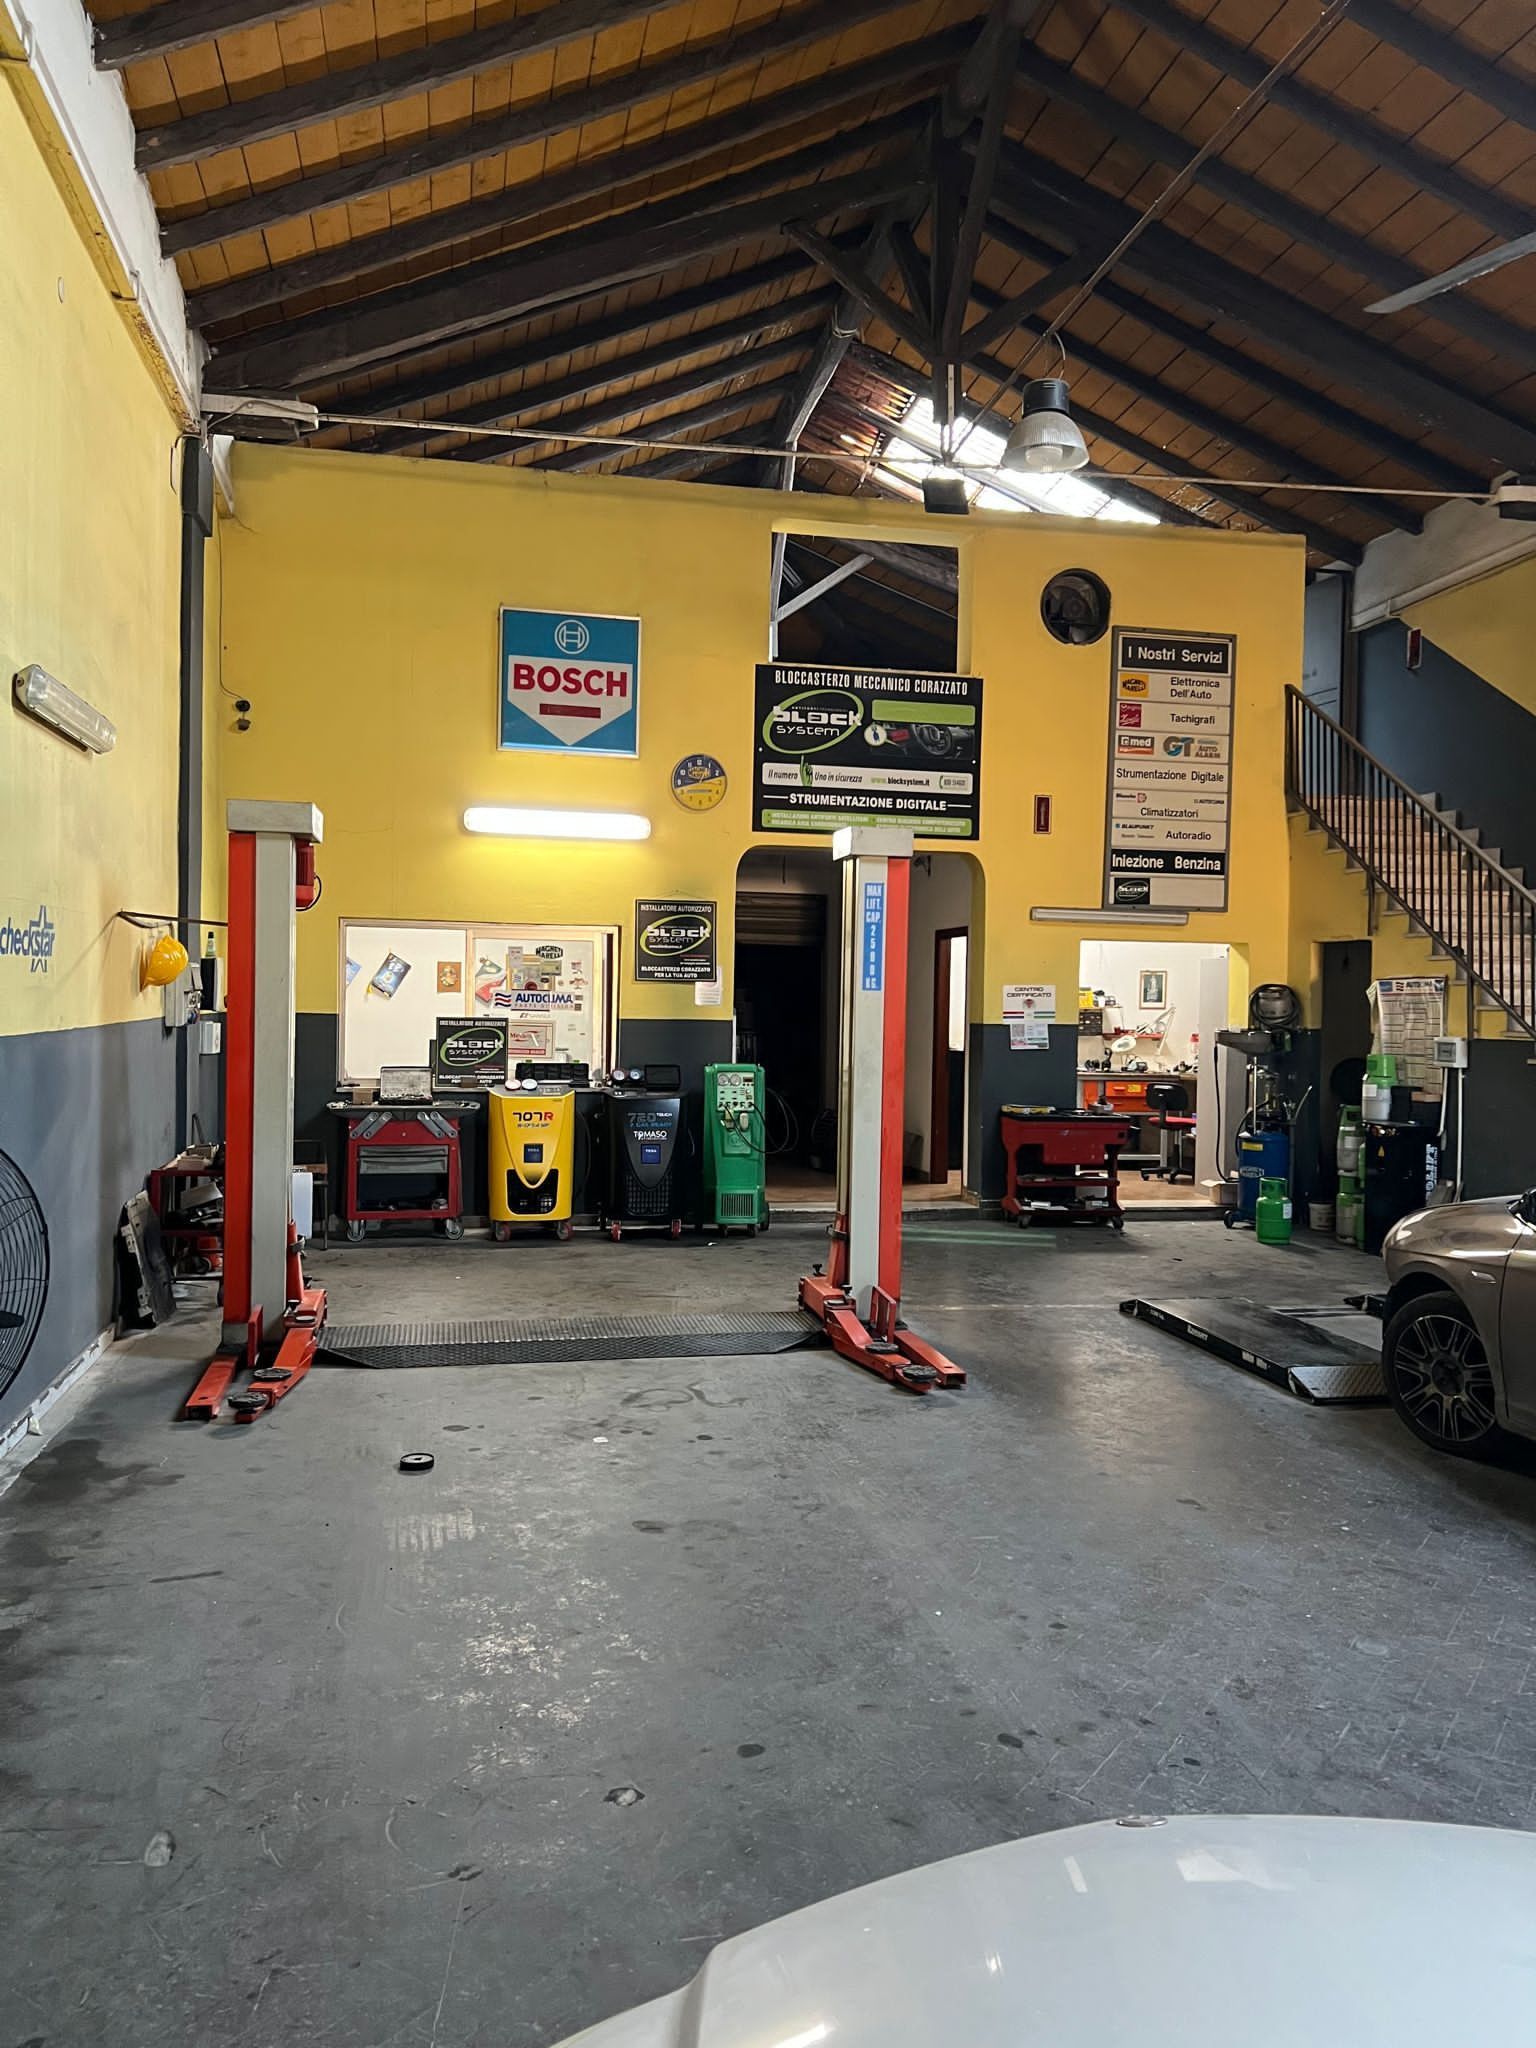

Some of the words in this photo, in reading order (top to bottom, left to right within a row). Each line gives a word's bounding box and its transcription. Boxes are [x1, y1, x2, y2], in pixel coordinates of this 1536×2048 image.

[1128, 646, 1132, 659] I
[1138, 646, 1175, 661] Nostri
[1181, 649, 1223, 664] Servizi
[513, 663, 627, 697] BOSCH
[775, 670, 850, 688] BLOCCASTERZO
[854, 675, 911, 692] MECCANICO
[914, 679, 968, 696] CORAZZATO
[1170, 676, 1220, 688] Elettronica
[1170, 688, 1212, 699] Dell'Auto
[1170, 713, 1215, 726] Tachigrafi
[768, 770, 774, 779] Il
[774, 772, 798, 780] numero
[814, 773, 827, 782] Uno
[835, 774, 863, 784] sicurezza
[1116, 767, 1186, 781] Strumentazione
[1191, 771, 1224, 784] Digitale
[789, 793, 893, 809] STRUMENTAZIONE
[896, 799, 947, 811] DIGITALE
[1140, 807, 1199, 818] Climatizzatori
[1166, 831, 1211, 841] Autoradio
[1112, 854, 1164, 868] Iniezione
[1174, 855, 1221, 870] Benzina
[866, 884, 882, 896] MAX
[640, 904, 677, 912] INSTALLATORE
[677, 905, 712, 913] AUTORIZZATO
[0, 917, 56, 957] checkstar
[515, 993, 573, 1003] AUTOCLIMA
[512, 1111, 554, 1122] 707R
[627, 1112, 656, 1123] 720
[633, 1130, 667, 1140] TOMASO
